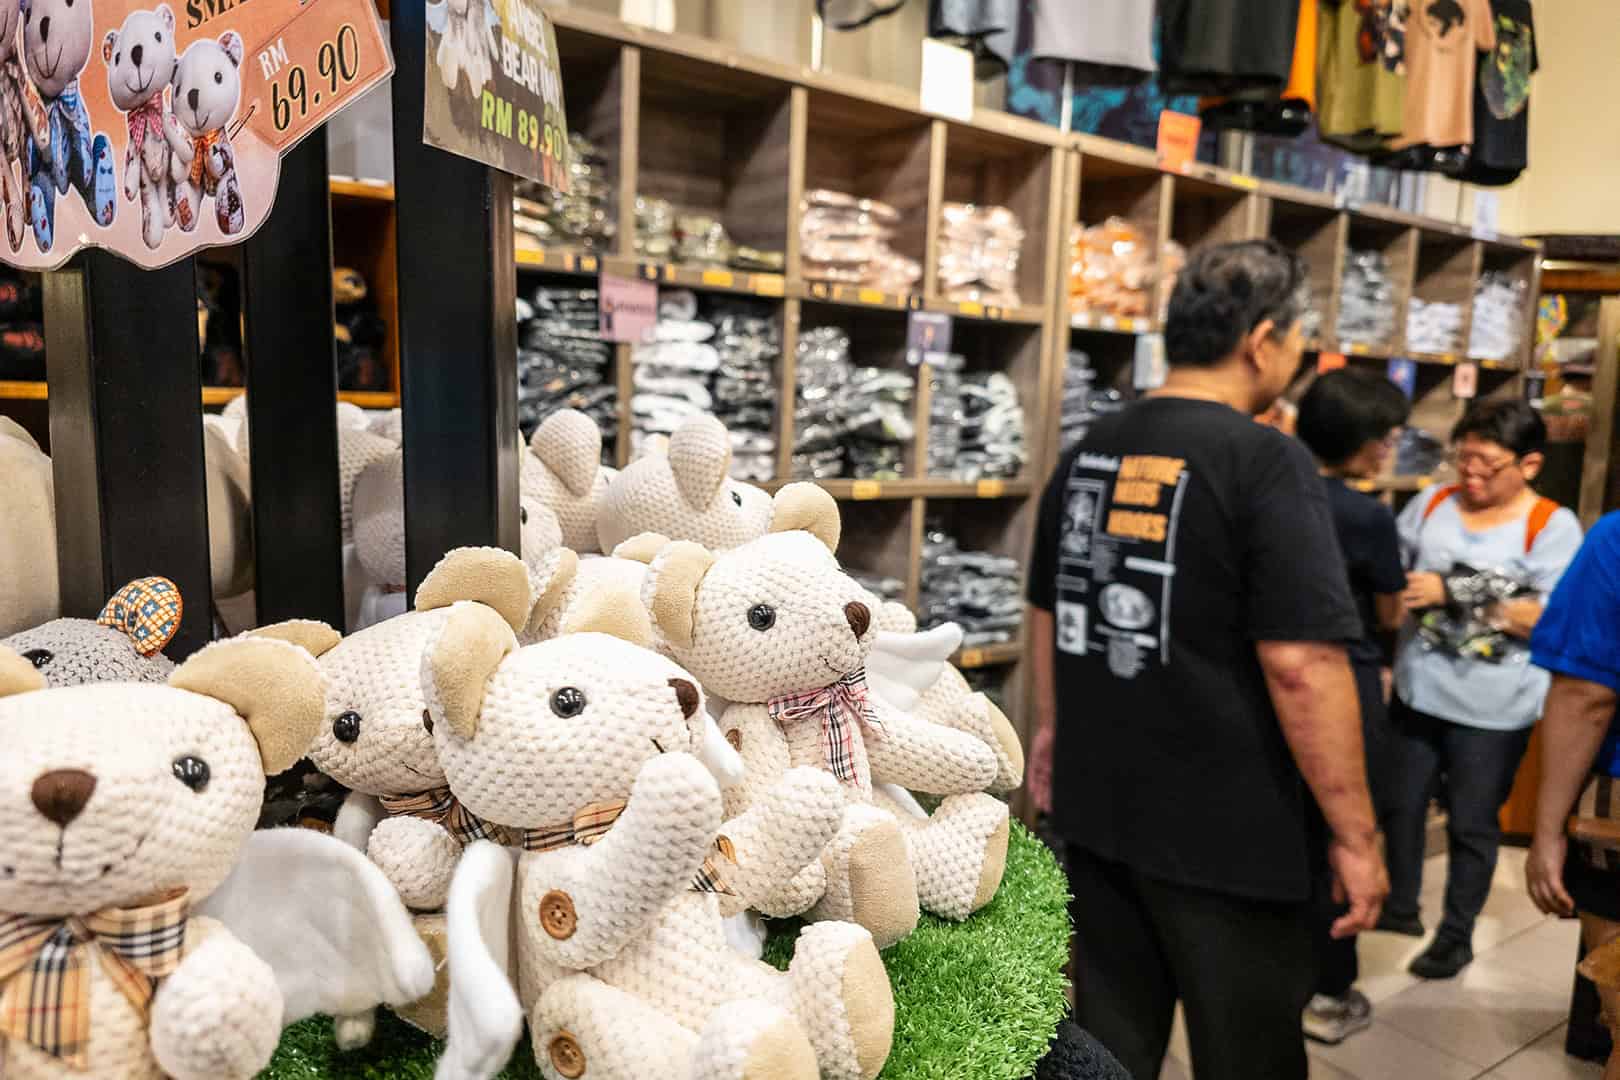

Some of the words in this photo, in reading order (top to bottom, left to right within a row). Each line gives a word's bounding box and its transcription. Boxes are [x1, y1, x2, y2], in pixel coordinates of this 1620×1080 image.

[258, 37, 290, 81] RM
[271, 24, 360, 131] 69.90
[501, 35, 540, 96] BEAR
[481, 89, 512, 139] RM
[517, 109, 562, 162] 89.90
